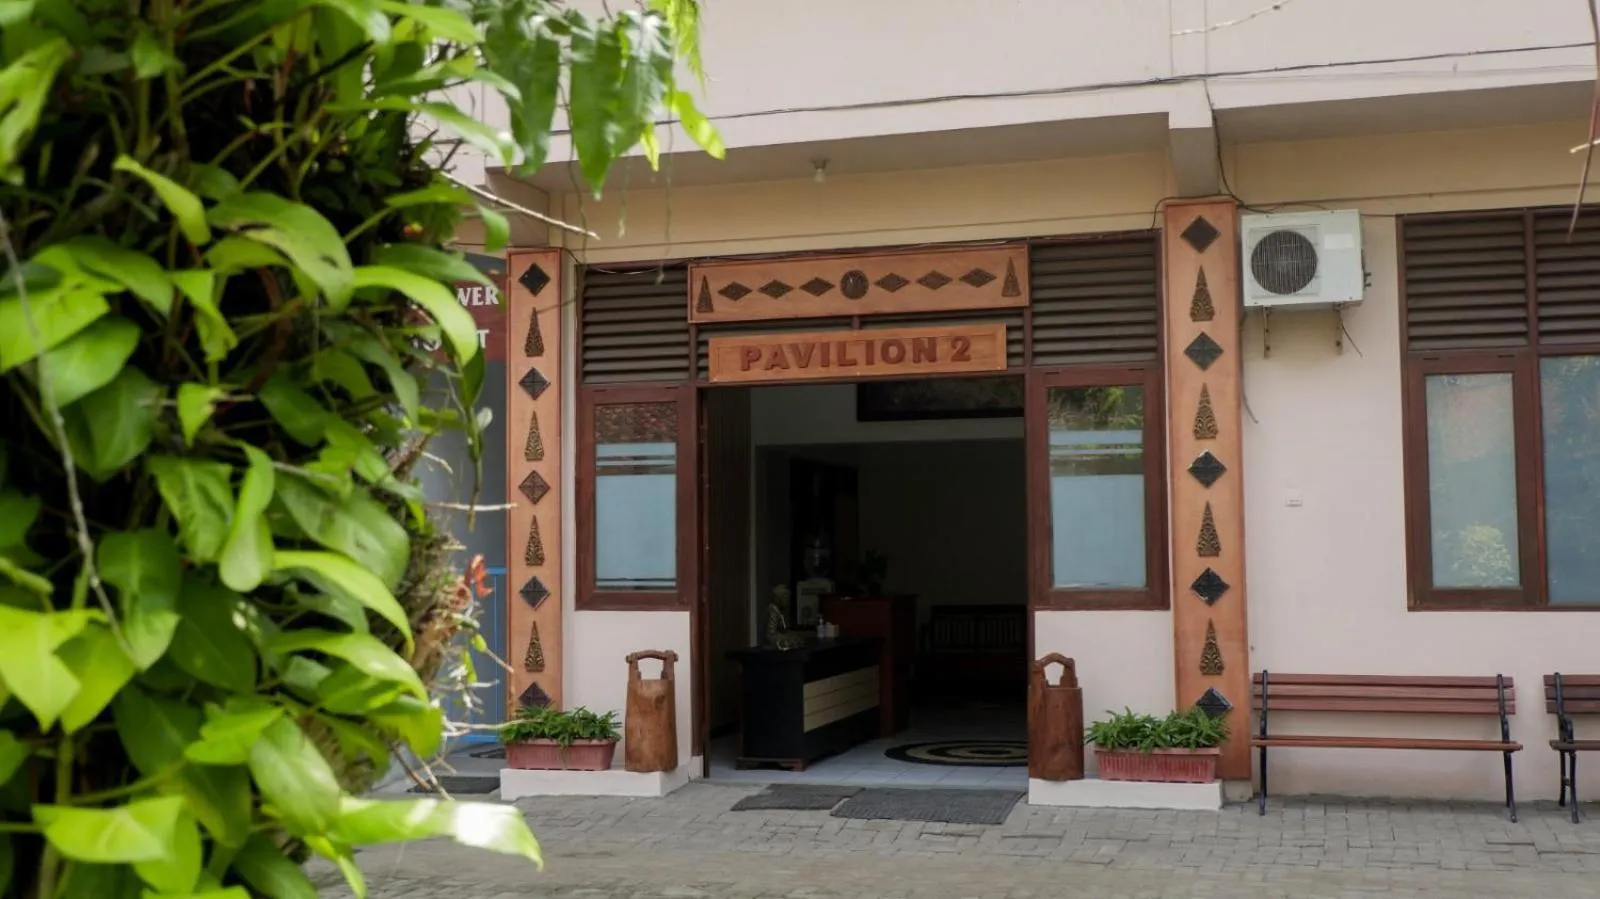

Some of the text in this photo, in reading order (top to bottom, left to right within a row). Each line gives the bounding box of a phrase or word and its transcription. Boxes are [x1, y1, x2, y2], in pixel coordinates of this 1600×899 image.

[456, 285, 500, 307] WER
[740, 335, 973, 372] PAVILION 2
